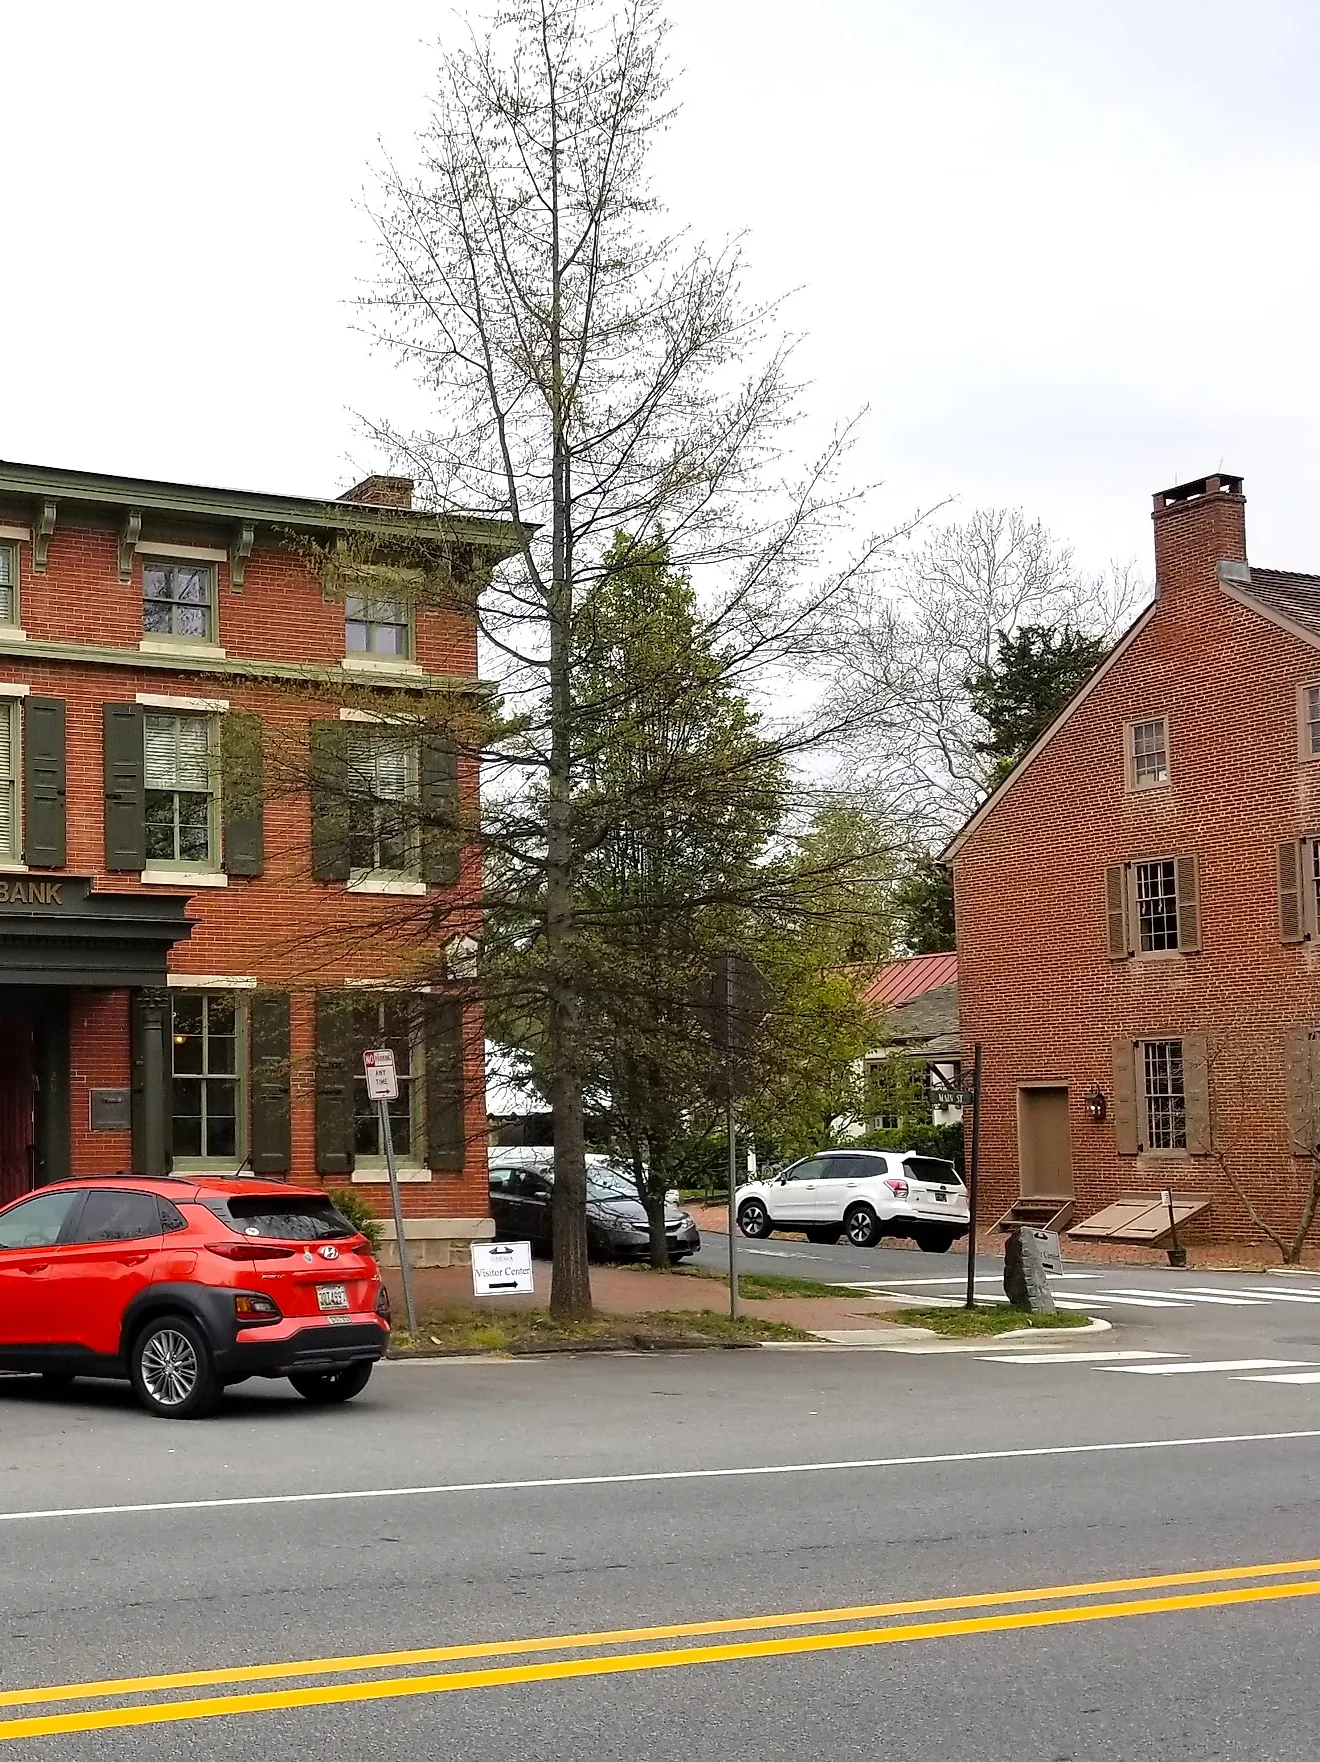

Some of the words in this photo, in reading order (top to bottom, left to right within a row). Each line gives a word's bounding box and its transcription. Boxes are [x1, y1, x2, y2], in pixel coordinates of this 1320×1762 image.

[376, 1078, 389, 1086] TIME
[475, 1268, 503, 1278] Visitor
[504, 1266, 530, 1276] Center
